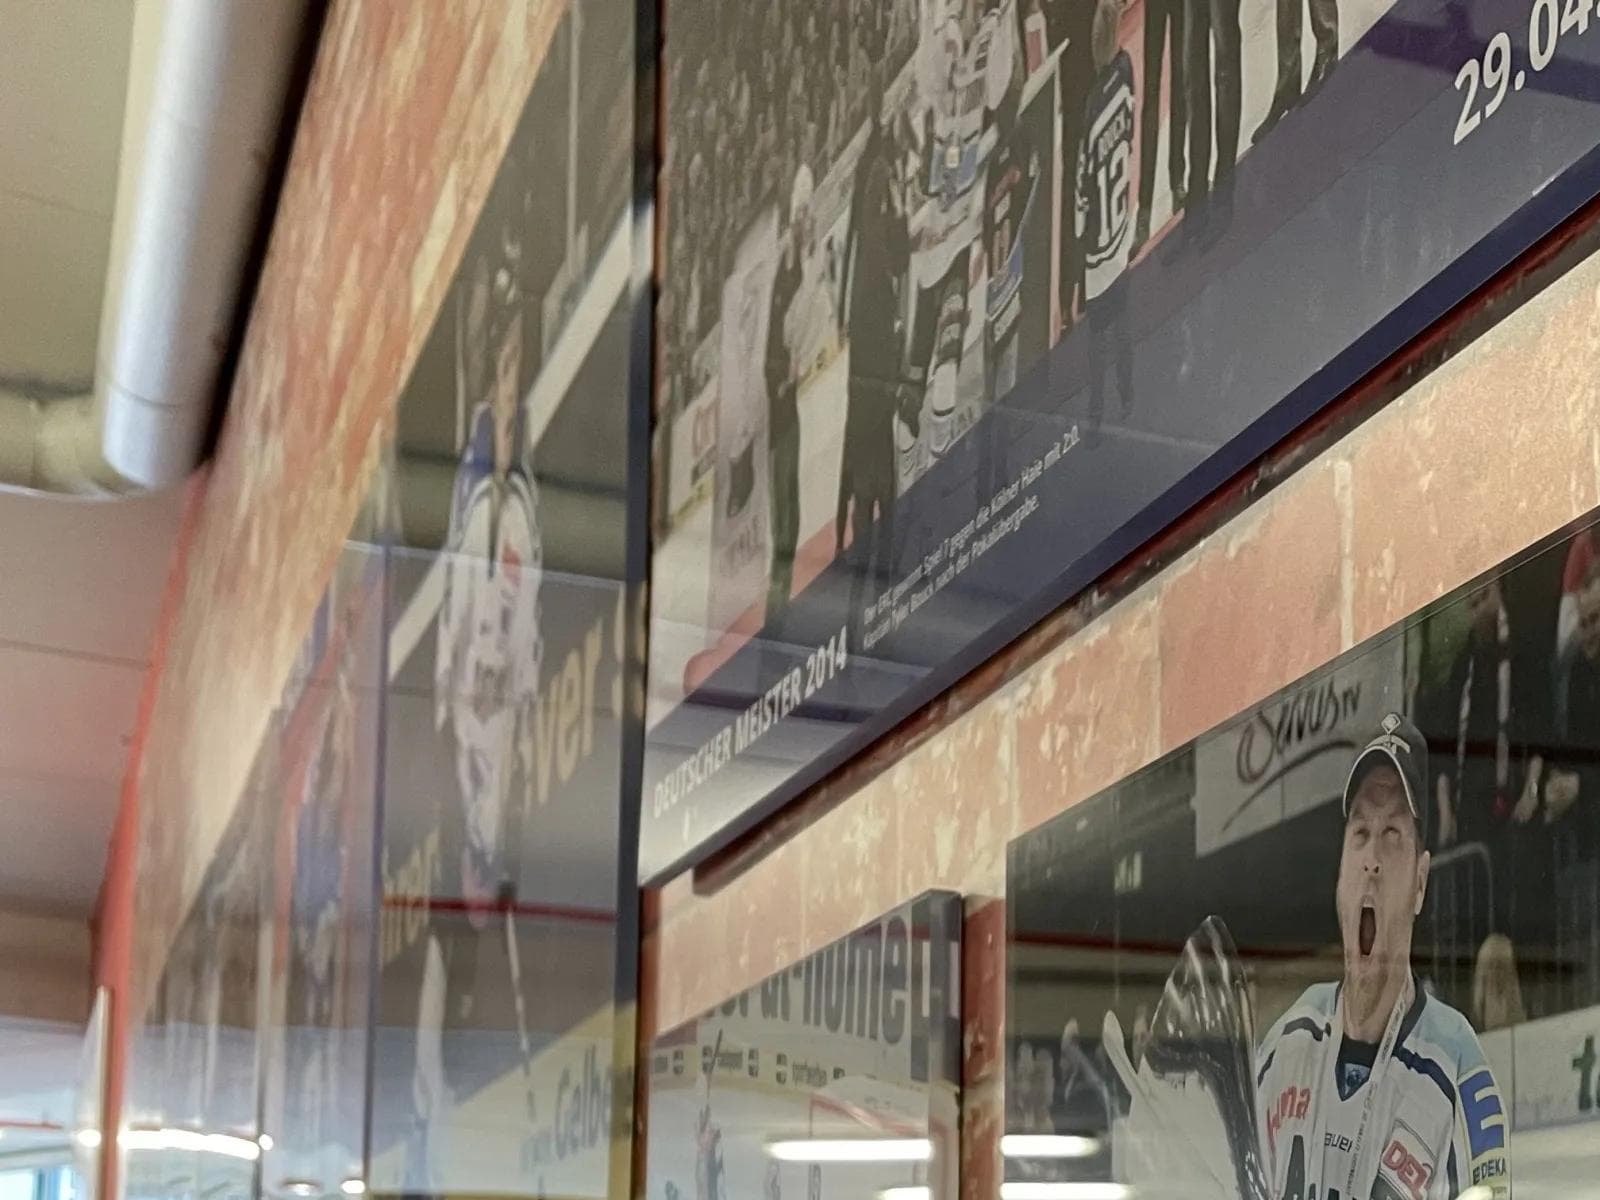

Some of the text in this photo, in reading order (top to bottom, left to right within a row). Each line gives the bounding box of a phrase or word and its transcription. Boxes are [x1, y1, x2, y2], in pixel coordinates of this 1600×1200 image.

[1096, 139, 1131, 249] 12
[949, 519, 975, 558] gegen
[654, 624, 847, 820] DEUTSCHER MEISTER 2014
[1472, 1157, 1508, 1186] EDEKA
